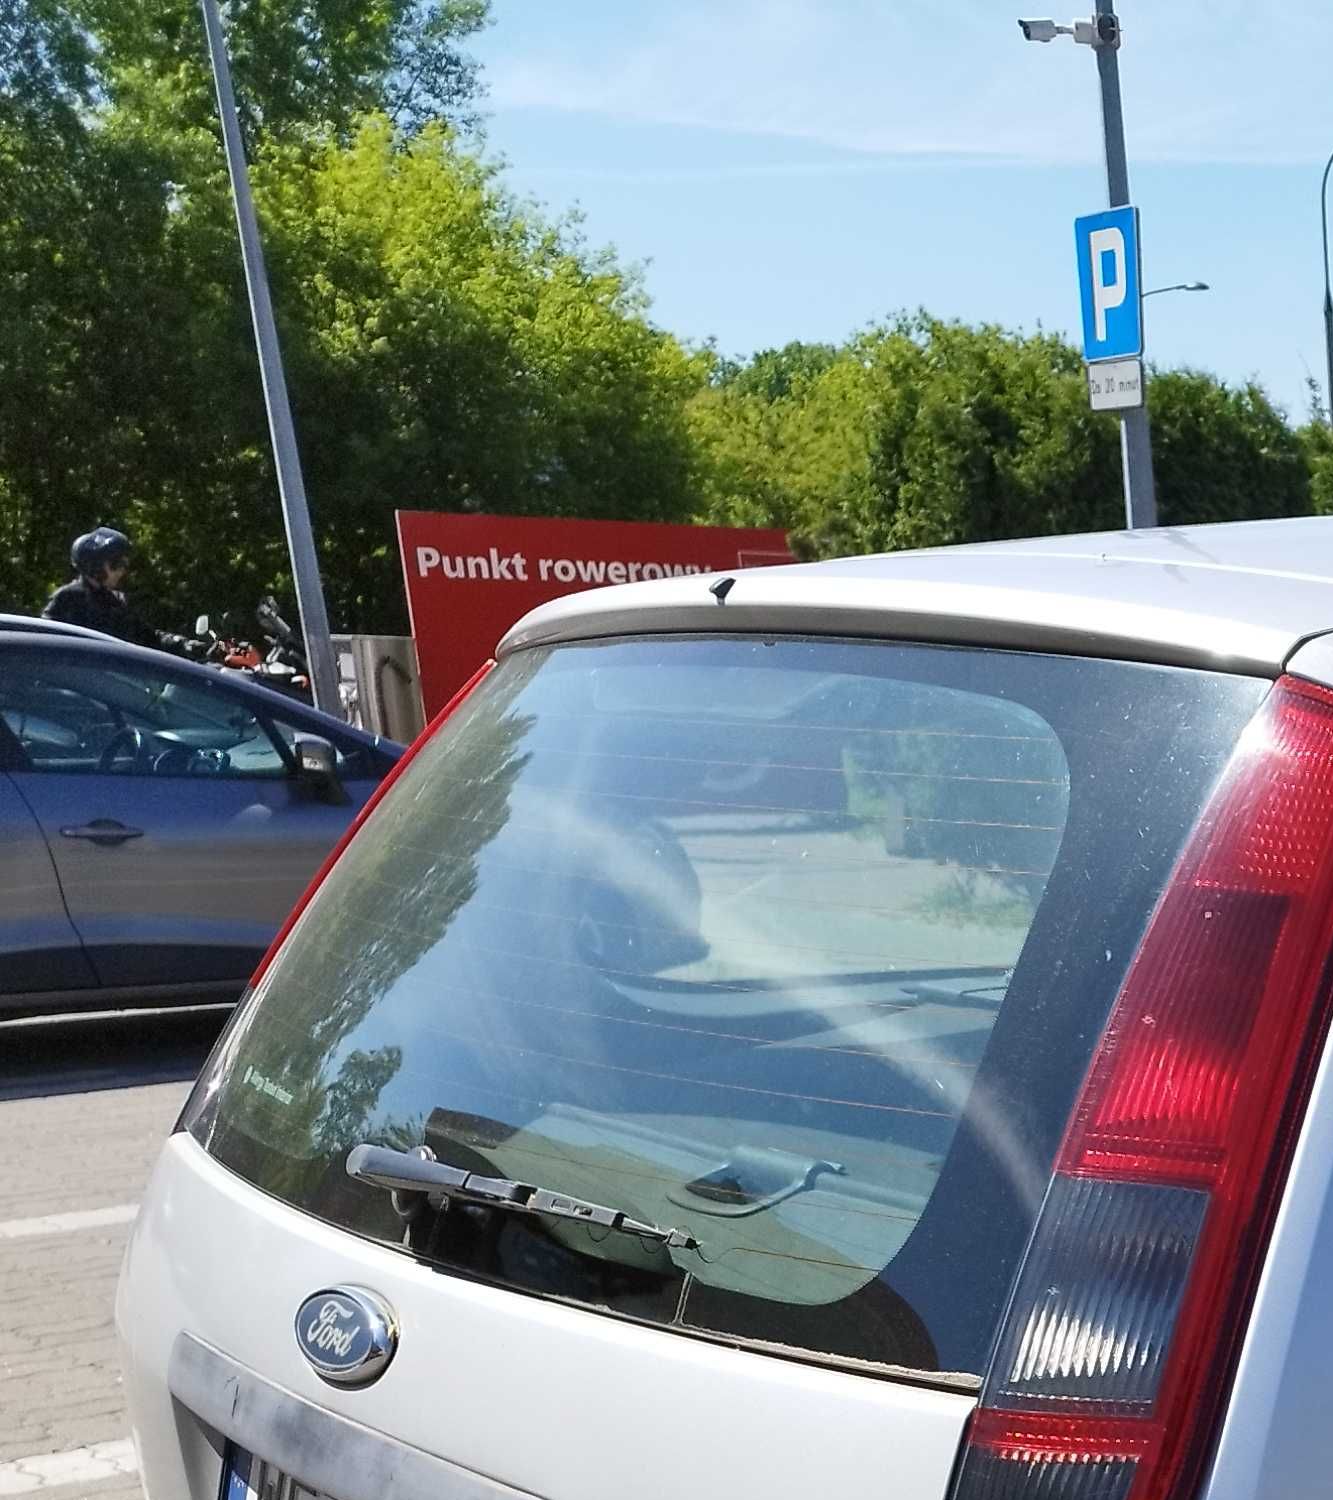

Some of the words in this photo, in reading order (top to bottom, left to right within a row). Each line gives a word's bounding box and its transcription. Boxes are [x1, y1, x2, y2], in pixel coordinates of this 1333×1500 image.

[1090, 227, 1127, 342] P
[415, 546, 528, 582] Punkt
[307, 1300, 361, 1357] Ford
